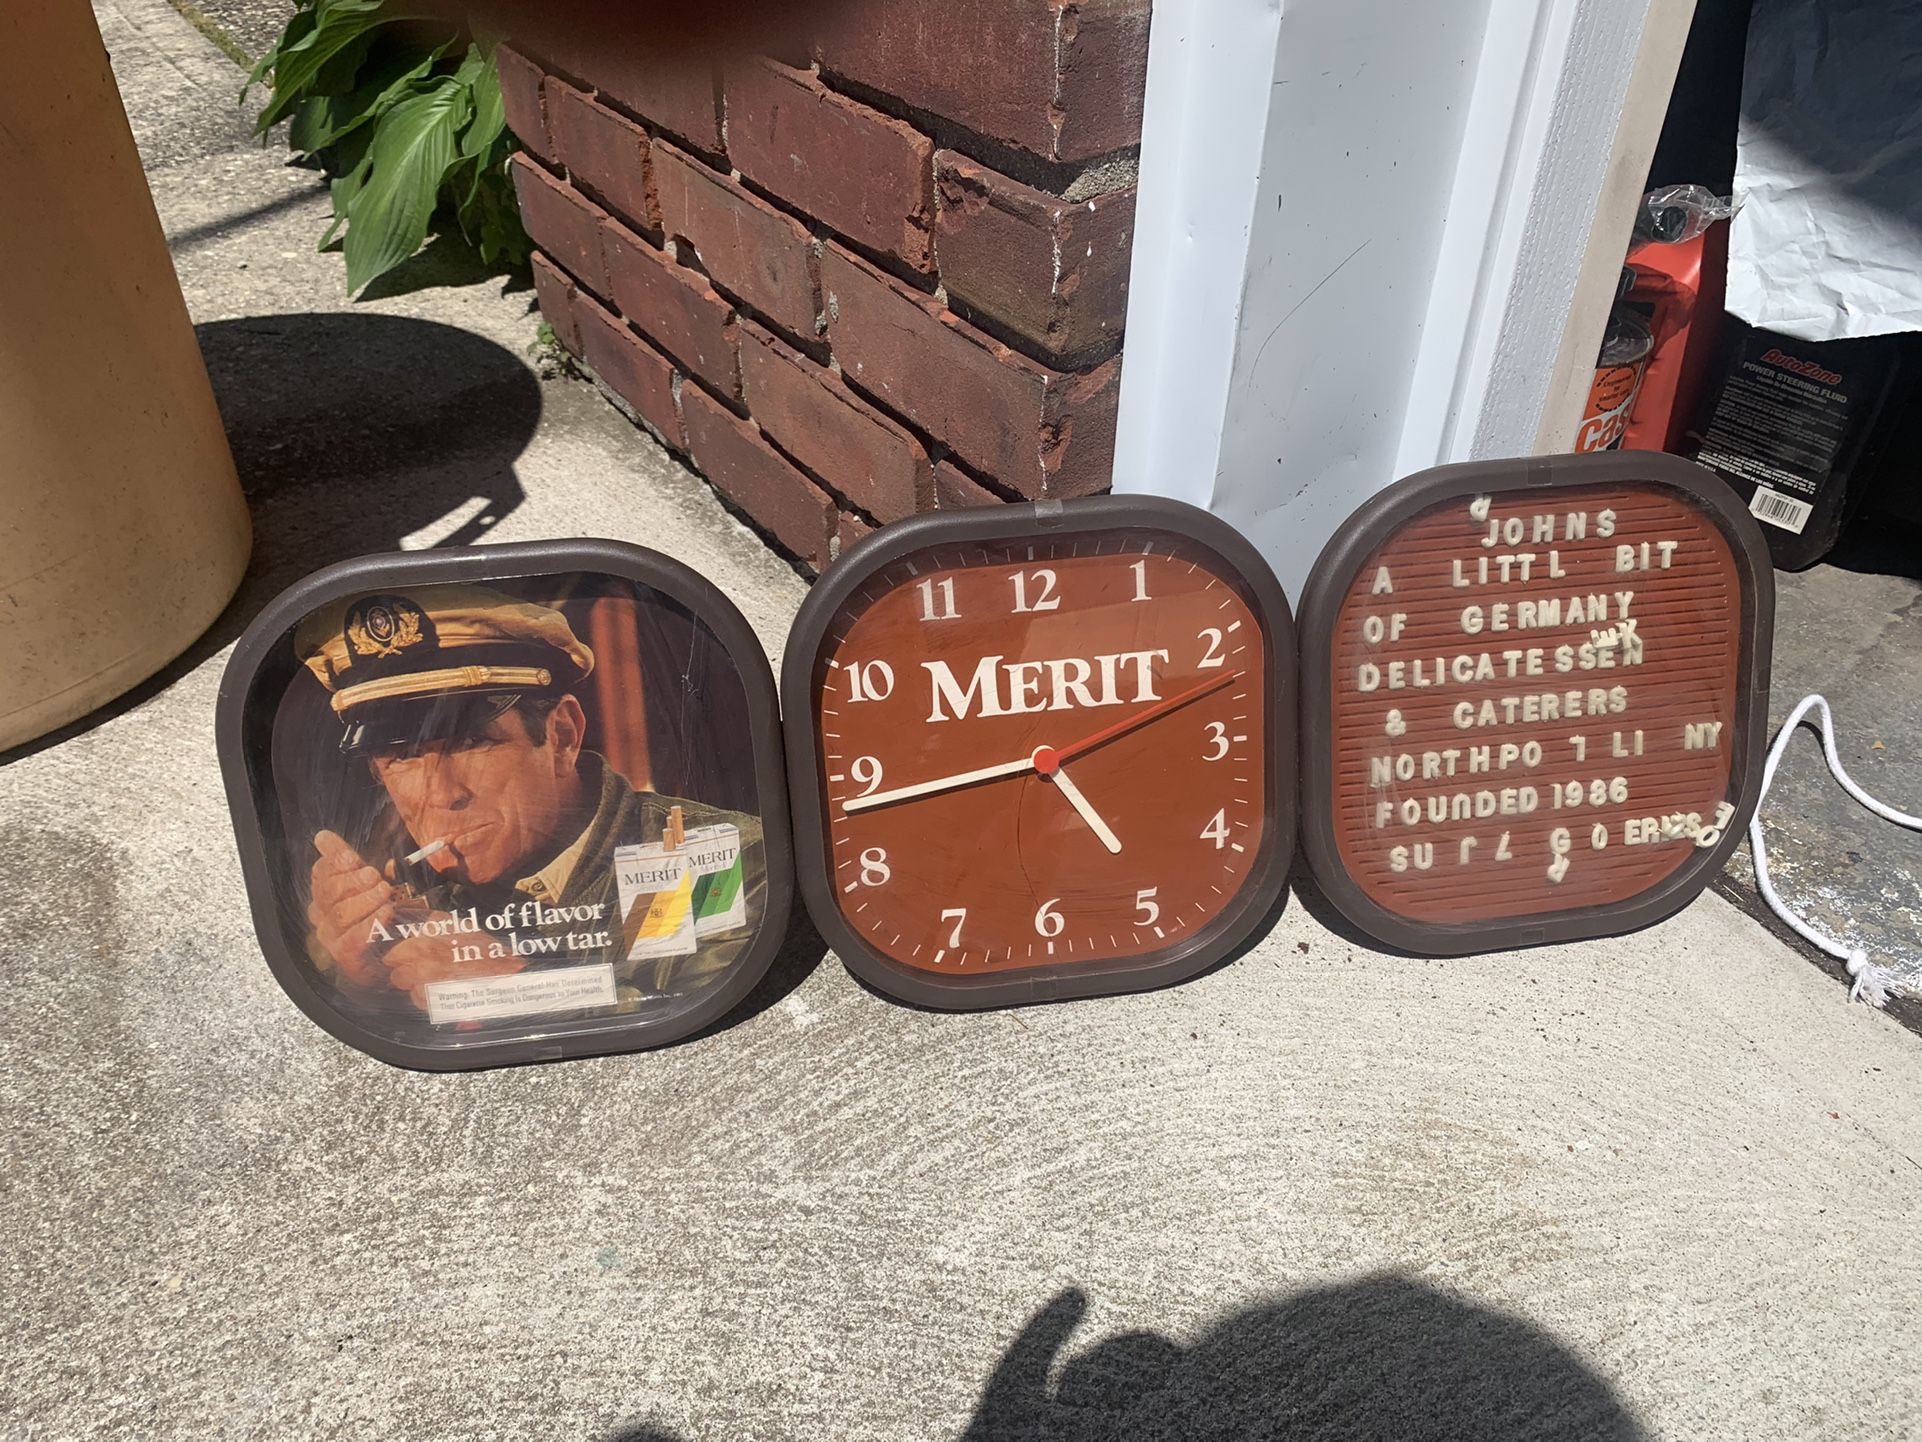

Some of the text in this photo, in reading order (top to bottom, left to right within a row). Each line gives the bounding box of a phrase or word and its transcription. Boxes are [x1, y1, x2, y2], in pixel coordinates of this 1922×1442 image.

[1743, 361, 1776, 378] POWER
[1776, 373, 1820, 394] STEERING
[1820, 388, 1848, 403] FLUID
[1760, 348, 1843, 386] AutoZone
[1481, 508, 1617, 548] JOHNS
[1129, 560, 1152, 602] 1
[1371, 566, 1394, 594] A
[1615, 540, 1678, 573] BIT
[916, 576, 962, 622] 11
[1008, 568, 1061, 613] 12
[1362, 590, 1635, 644] OF GERMANY
[1197, 627, 1226, 669] 2
[843, 659, 895, 704] 10
[920, 648, 1170, 724] MERIT
[1384, 684, 1628, 738] & CATERERS
[1201, 721, 1230, 761] 3
[850, 756, 883, 797] 9
[1551, 776, 1629, 810] 1986
[1199, 808, 1231, 850] 4
[623, 867, 682, 886] MERIT
[688, 847, 737, 869] MERIT
[859, 847, 892, 887] 8
[366, 900, 606, 943] A world of flavor
[1034, 898, 1065, 937] 6
[1133, 886, 1160, 926] 5
[451, 929, 613, 963] in a low tar.
[940, 907, 968, 949] 7
